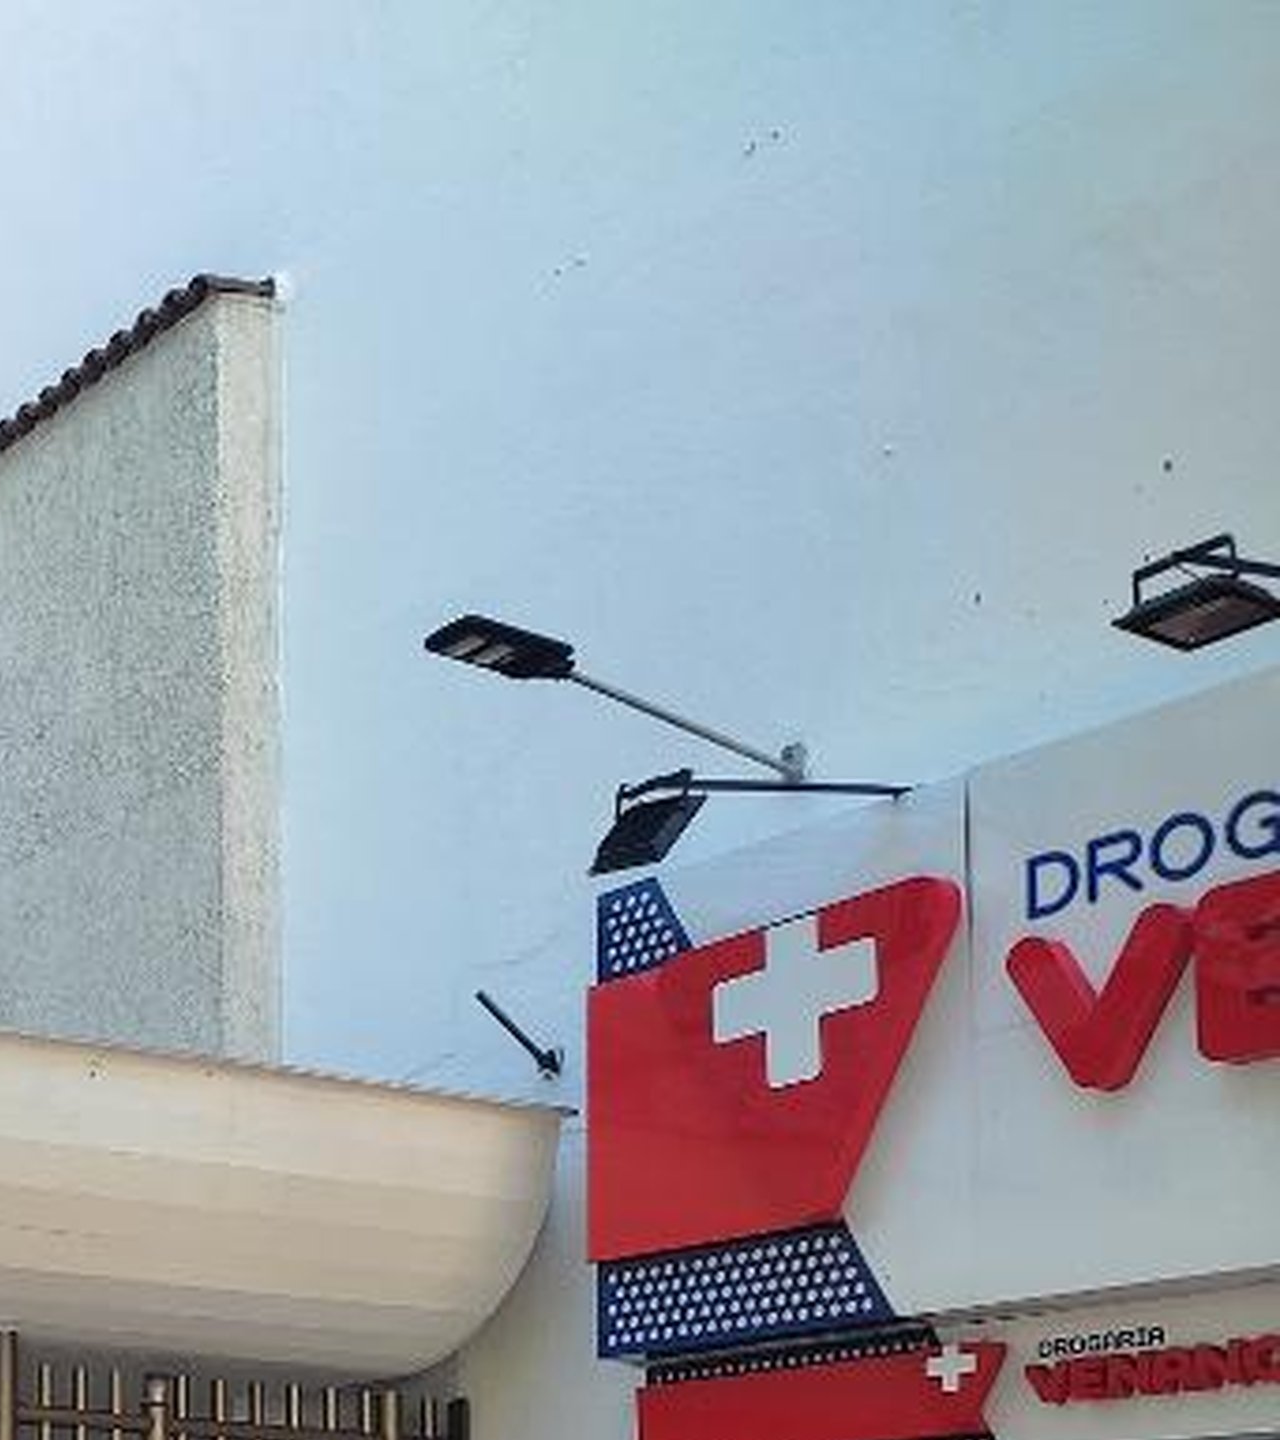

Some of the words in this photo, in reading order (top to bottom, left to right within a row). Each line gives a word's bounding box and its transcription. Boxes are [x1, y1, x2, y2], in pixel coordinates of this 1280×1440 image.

[1026, 790, 1280, 919] DROG
[1006, 869, 1280, 1092] VE
[1039, 1326, 1166, 1358] DROGARIA
